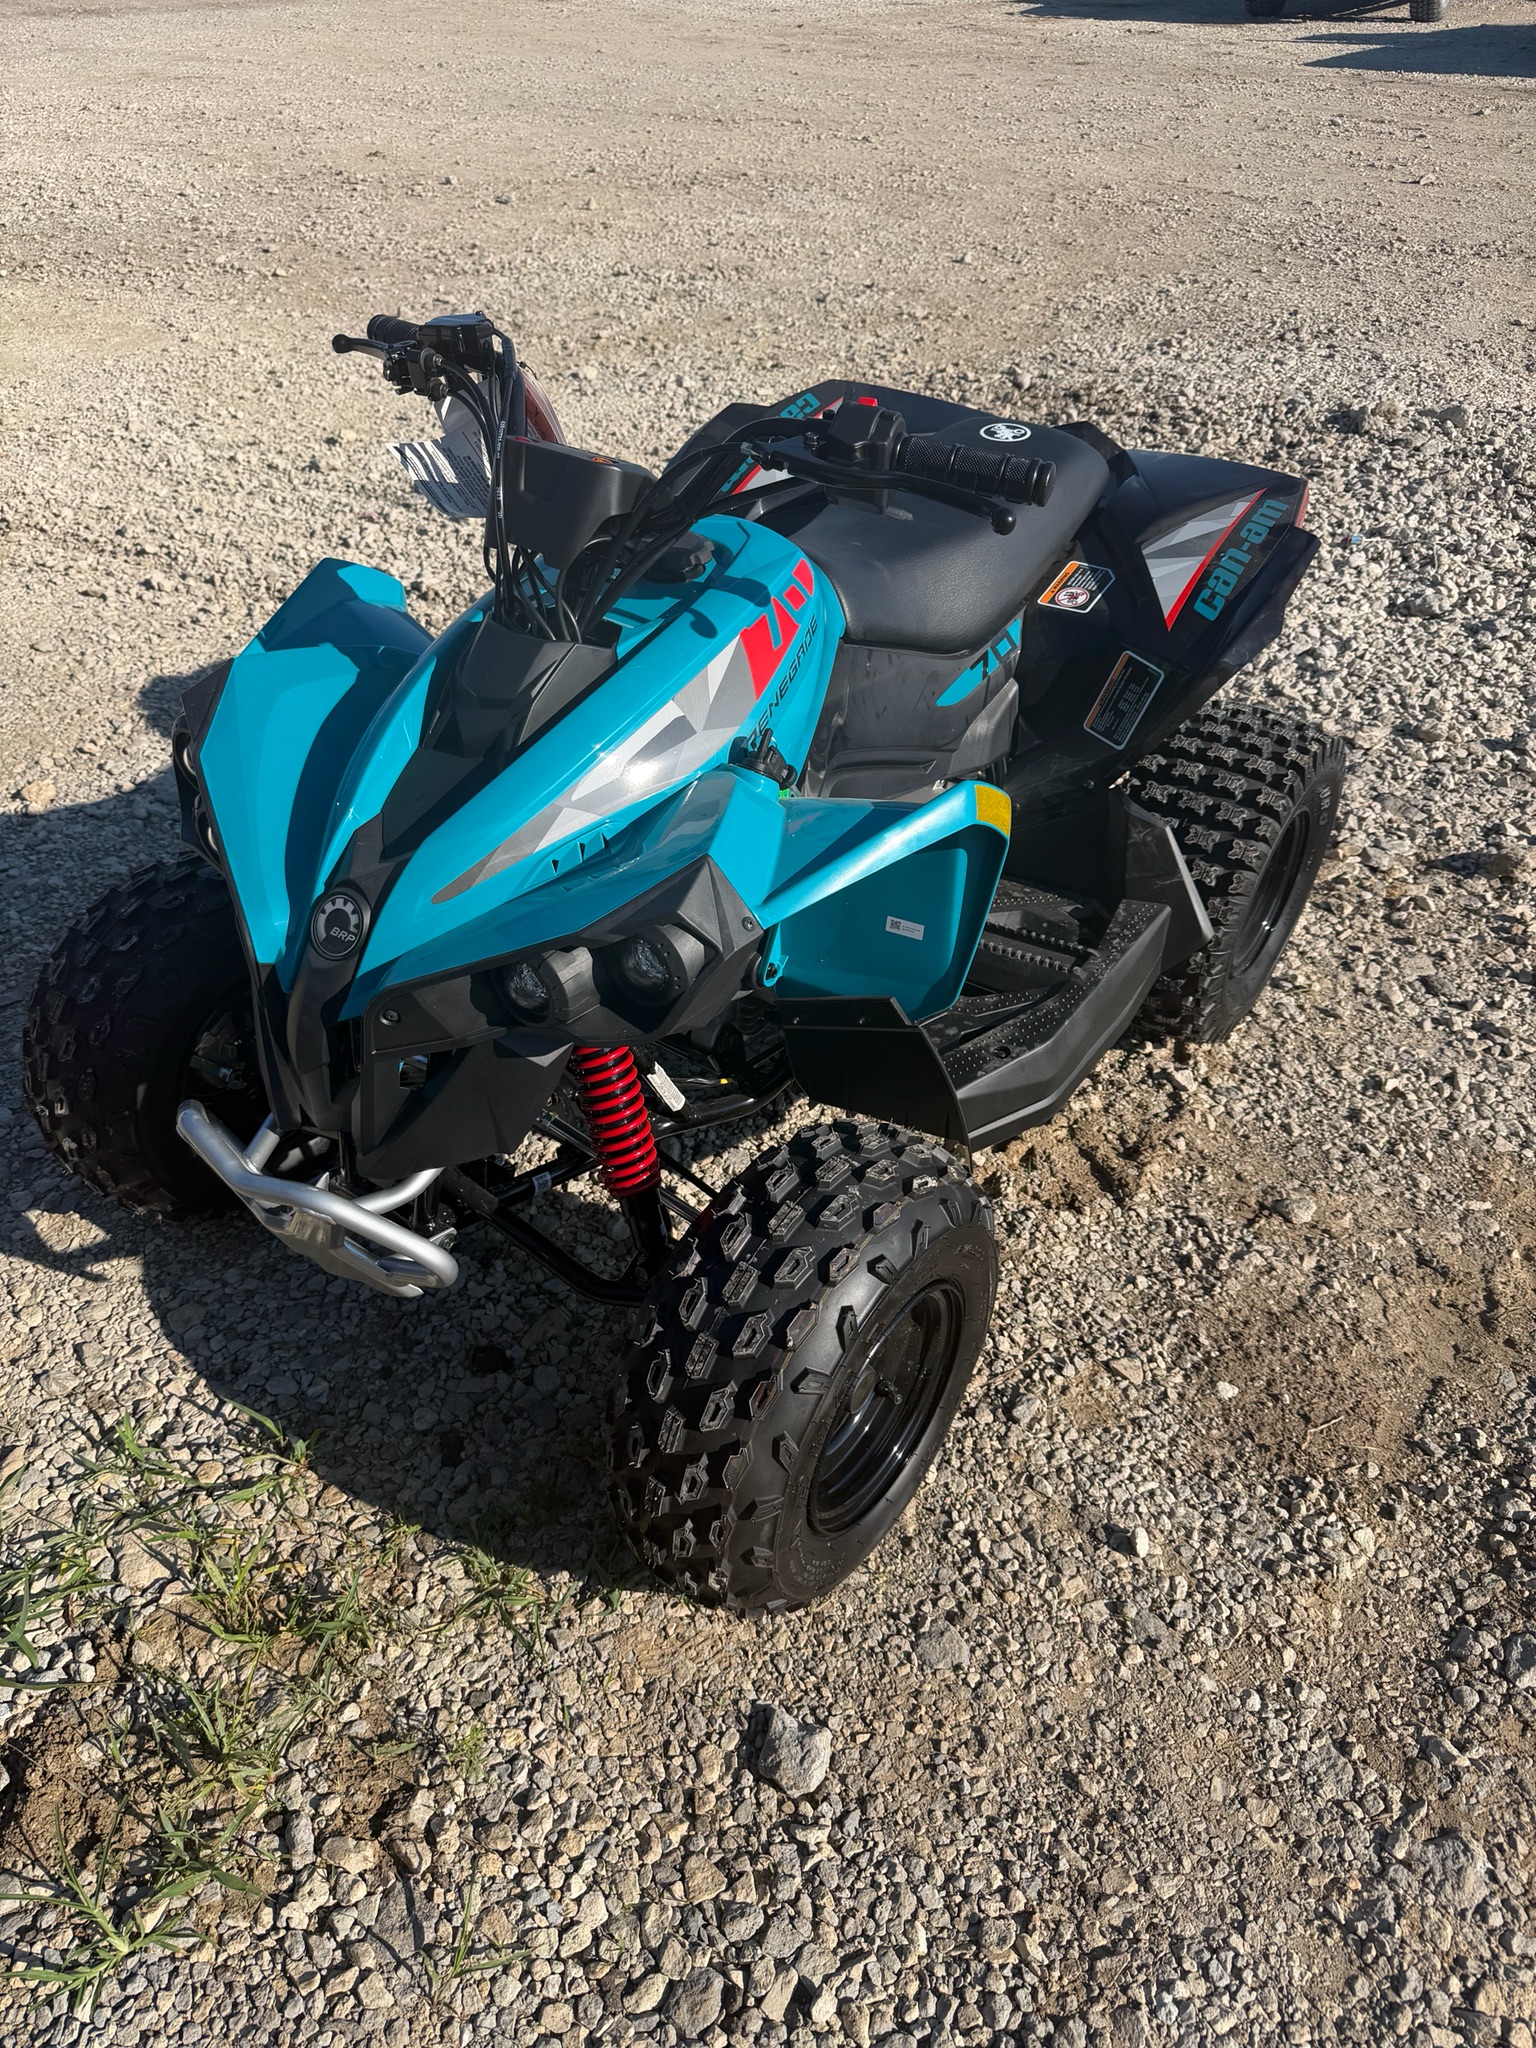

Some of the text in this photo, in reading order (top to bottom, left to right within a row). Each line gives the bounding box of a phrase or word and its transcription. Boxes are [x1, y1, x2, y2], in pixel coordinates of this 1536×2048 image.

[1193, 499, 1289, 621] can-am
[748, 613, 819, 752] RENEGADE
[329, 926, 356, 942] BRP
